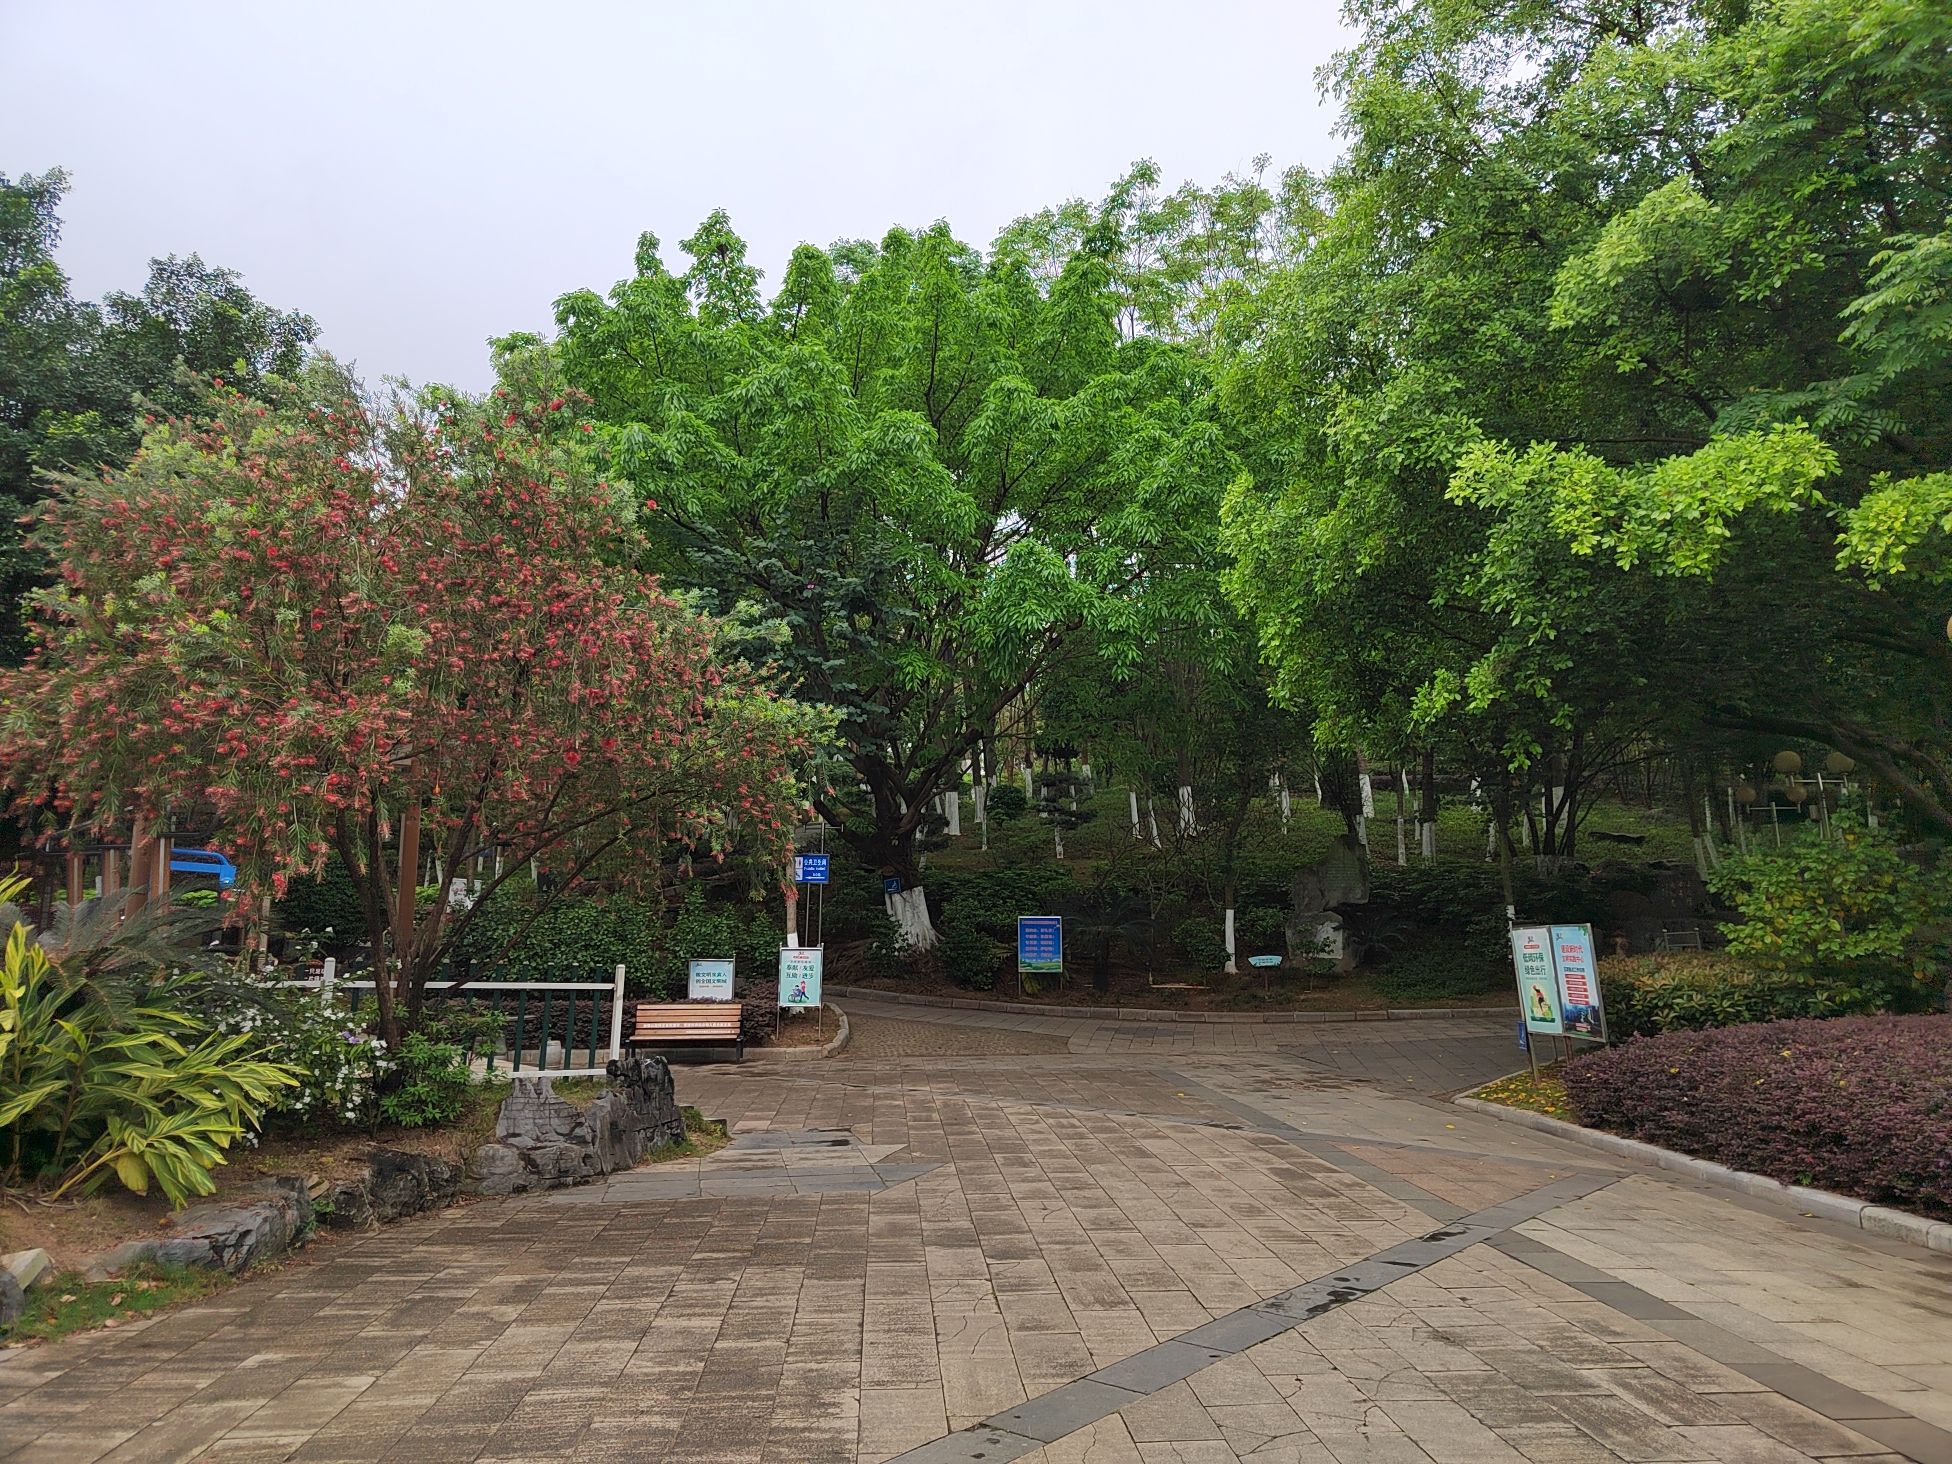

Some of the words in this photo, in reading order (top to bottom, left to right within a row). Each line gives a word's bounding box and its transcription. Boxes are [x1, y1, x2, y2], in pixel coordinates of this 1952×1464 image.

[803, 858, 827, 866] 公共卫生间
[1523, 952, 1545, 963] 低碳环保
[1524, 965, 1546, 976] 绿色出行
